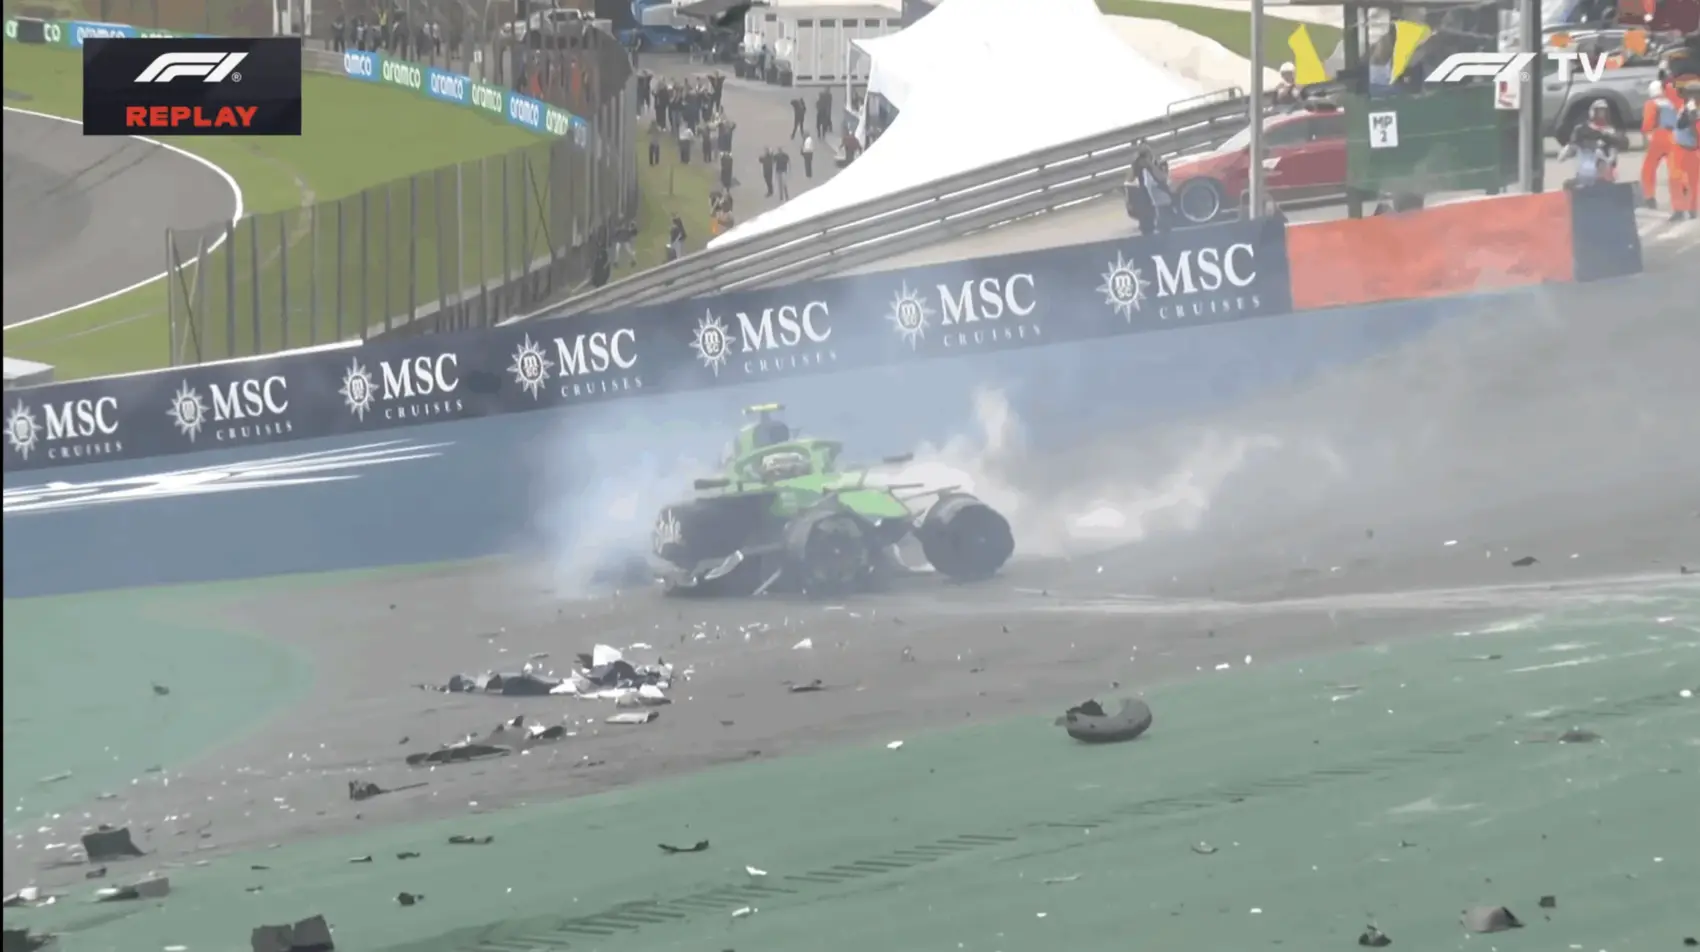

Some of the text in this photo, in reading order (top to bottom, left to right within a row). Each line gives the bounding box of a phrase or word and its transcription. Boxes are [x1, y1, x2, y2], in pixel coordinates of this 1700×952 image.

[382, 59, 421, 90] aramco
[431, 72, 463, 100] aramco
[472, 84, 502, 112] aramco
[510, 96, 540, 127] aramco
[1373, 115, 1393, 130] MP
[1151, 243, 1257, 297] MSC
[936, 273, 1037, 326] MSC
[1160, 295, 1260, 319] CRUISES
[736, 300, 832, 353] MSC
[553, 328, 639, 377] MSC
[380, 353, 460, 400] MSC
[561, 376, 642, 397] CRUISES
[209, 376, 289, 421] MSC
[385, 398, 463, 420] CRUISES
[42, 396, 119, 440] MSC
[216, 420, 293, 440] CRUISES
